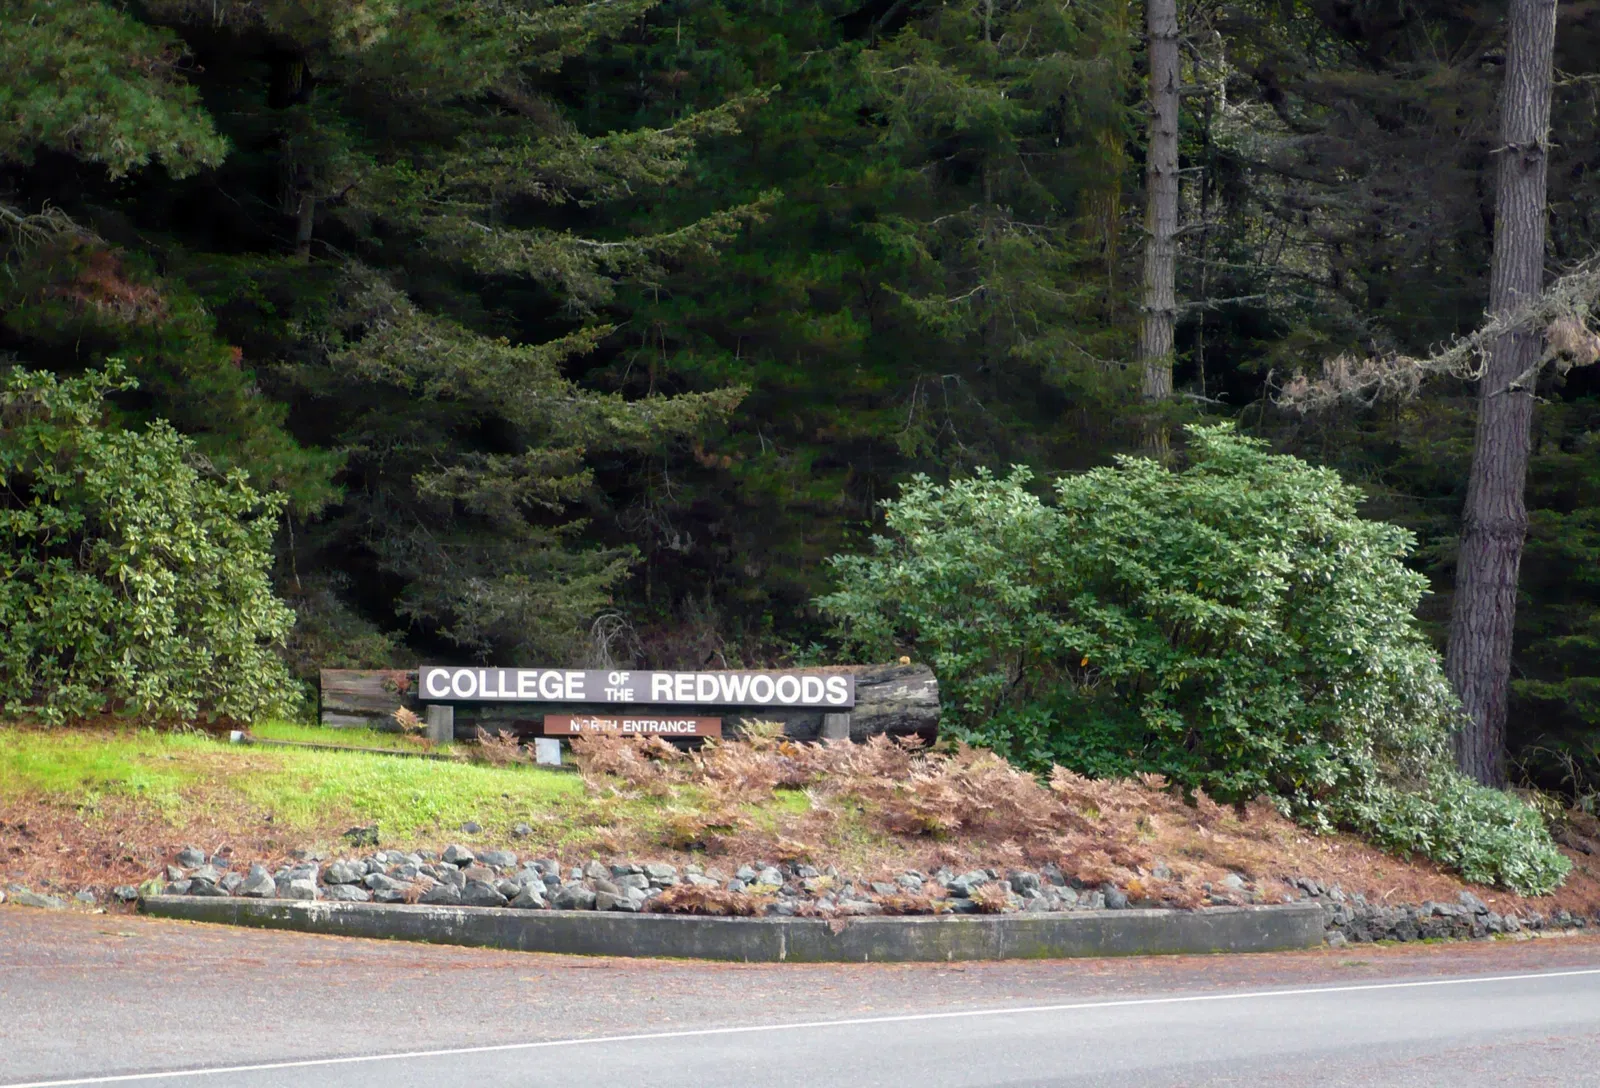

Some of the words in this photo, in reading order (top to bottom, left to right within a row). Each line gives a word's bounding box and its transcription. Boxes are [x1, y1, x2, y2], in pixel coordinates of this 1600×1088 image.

[426, 668, 586, 699] COLLEGE
[608, 671, 630, 685] OF
[604, 687, 634, 702] THE
[651, 673, 849, 704] REDWOODS
[623, 720, 696, 733] ENTRANCE
